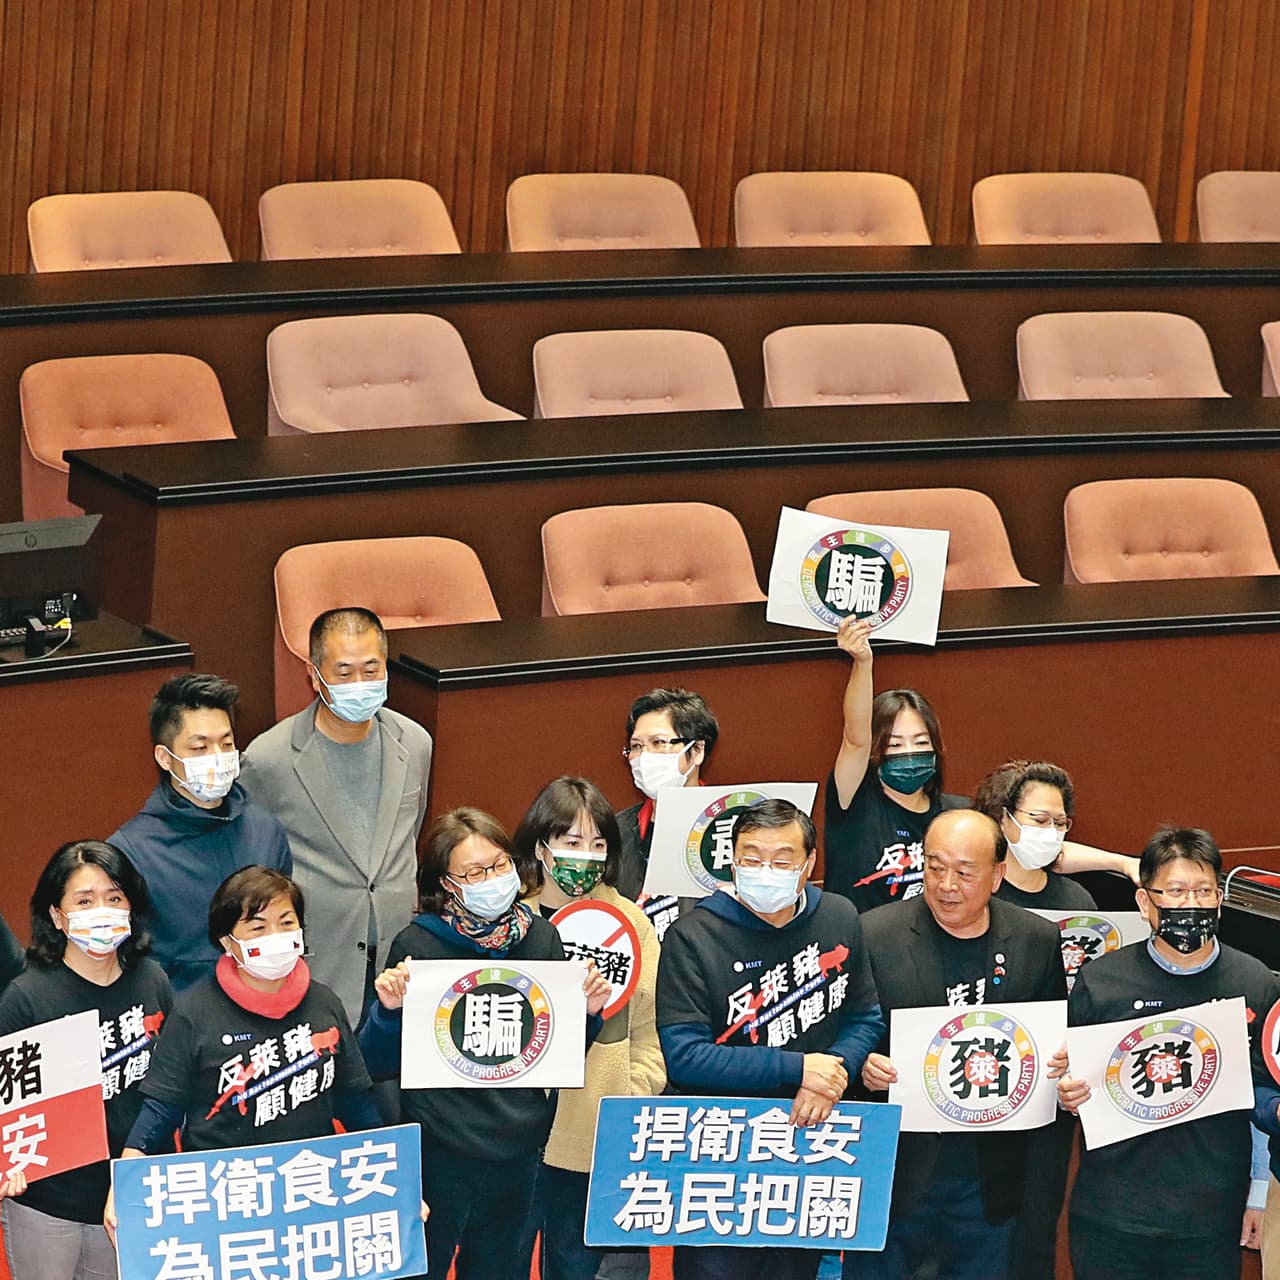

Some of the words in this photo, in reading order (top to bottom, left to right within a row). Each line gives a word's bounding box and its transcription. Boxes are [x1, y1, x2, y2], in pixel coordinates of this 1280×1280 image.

[825, 550, 886, 612] 騙
[891, 581, 907, 608] PARTY
[727, 942, 821, 1026] 反萊豬
[746, 961, 763, 969] KMT
[99, 1003, 145, 1058] 萊豬
[234, 1033, 253, 1042] KMT
[463, 993, 524, 1057] 騙
[768, 973, 849, 1048] 顧健康
[217, 1022, 313, 1095] 反萊豬
[436, 1018, 470, 1073] DEMOCRATIC
[472, 1047, 536, 1079] PROGRESSIVE
[532, 1018, 549, 1051] PARTY
[254, 1056, 336, 1128] 顧健康
[926, 1065, 959, 1117] DEMOCRATIC
[961, 1092, 1022, 1121] PROGRESSIVE
[1019, 1060, 1033, 1093] PARTY
[1107, 1074, 1147, 1117] DEMOCRATIC
[1149, 1082, 1207, 1118] PROGRESSIVE
[1203, 1054, 1215, 1080] PARTY
[629, 1106, 862, 1165] 捍衛食安
[142, 1140, 398, 1228] 捍衛食安
[613, 1172, 862, 1239] 為民把關
